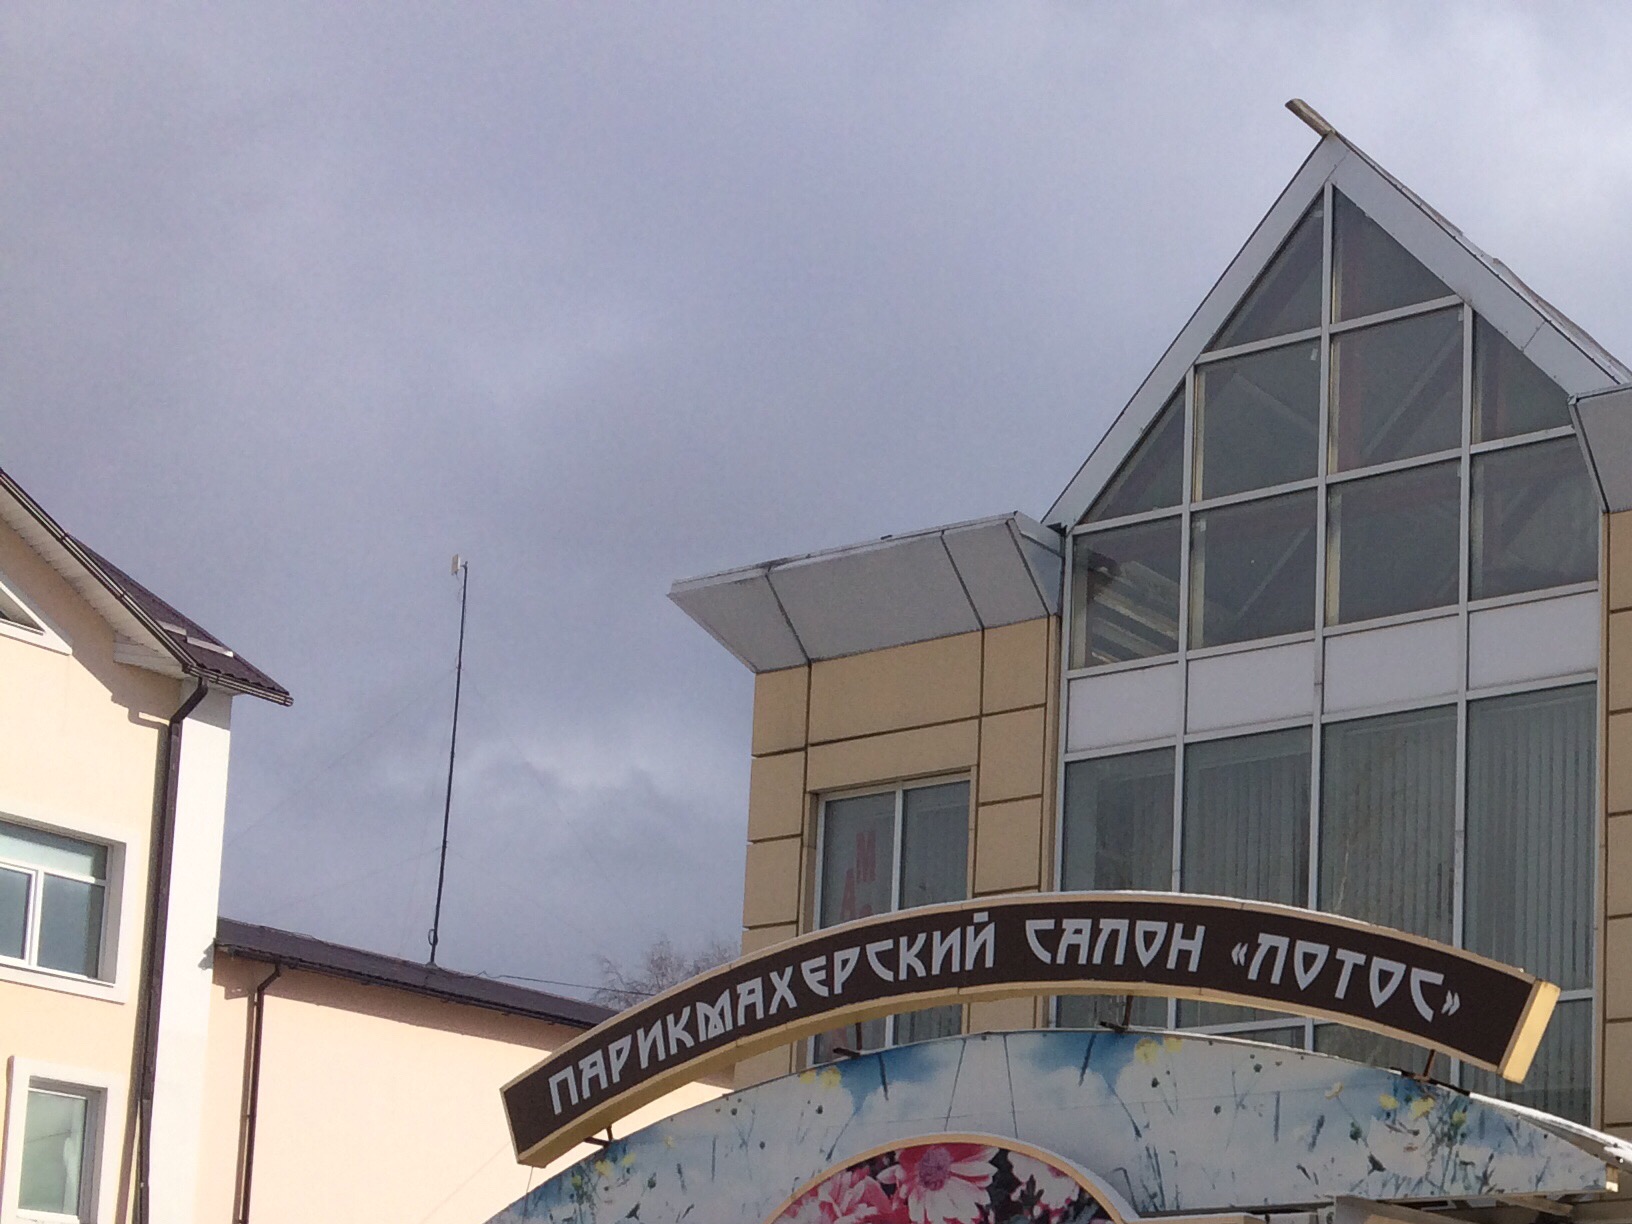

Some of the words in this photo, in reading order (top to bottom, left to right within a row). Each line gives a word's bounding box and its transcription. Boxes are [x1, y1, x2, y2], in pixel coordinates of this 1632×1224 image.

[547, 911, 996, 1116] ПАРИКМАХЕРСКИЙ
[1025, 918, 1206, 973] САЛОН
[1231, 931, 1461, 1022] «ЛОТОС»
